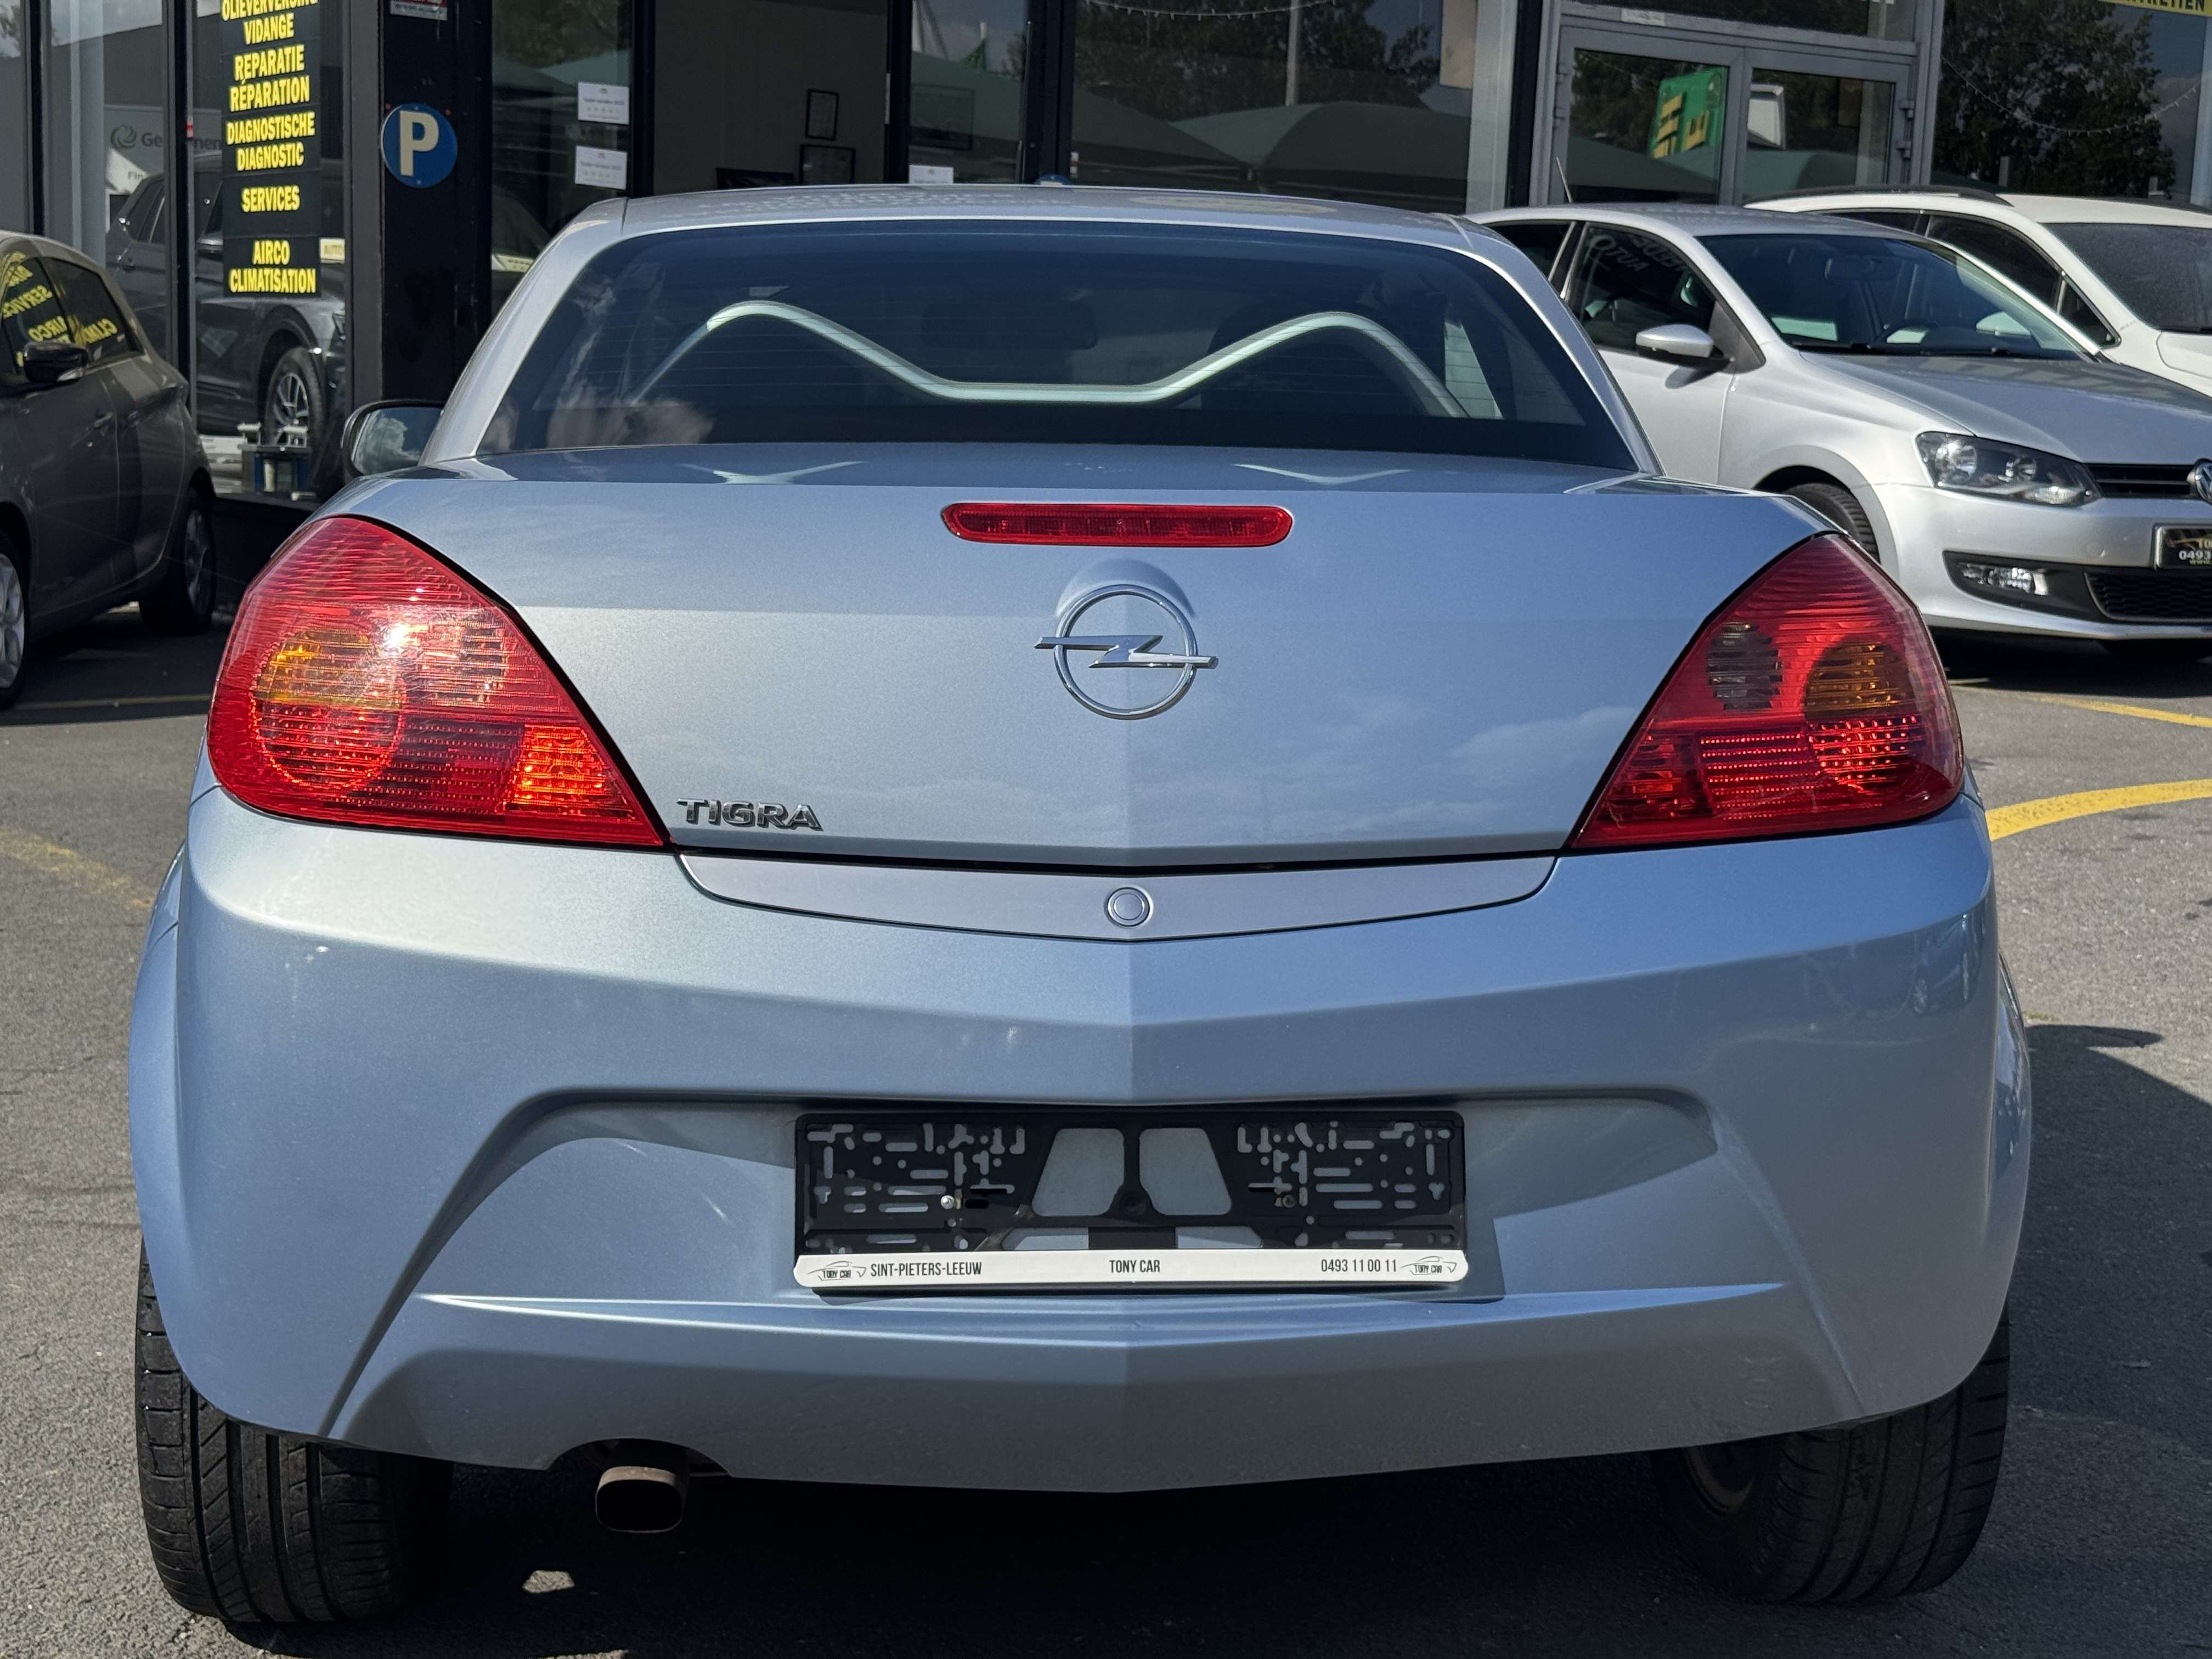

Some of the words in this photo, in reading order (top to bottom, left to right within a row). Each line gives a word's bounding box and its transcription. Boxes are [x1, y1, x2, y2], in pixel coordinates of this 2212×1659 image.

[243, 12, 295, 45] VIDANGE
[234, 44, 304, 81] REPARATIE
[230, 75, 310, 112] RÉPARATION
[227, 111, 315, 145] DIAGNOSTISCHE
[236, 142, 304, 171] DIAGNOSTIC
[399, 110, 439, 176] P
[241, 185, 301, 213] SERVICES
[252, 239, 291, 266] AIRCO
[229, 268, 317, 294] CLIMATISATION
[676, 797, 823, 832] TIGRA
[871, 1261, 982, 1277] SINT-PIETERS-LEEUW
[1109, 1260, 1137, 1273] TONY
[1139, 1259, 1160, 1273] CAR
[1321, 1259, 1348, 1272] 0493
[1352, 1259, 1364, 1272] 11
[1368, 1259, 1381, 1272] 00
[1385, 1259, 1396, 1272] 11
